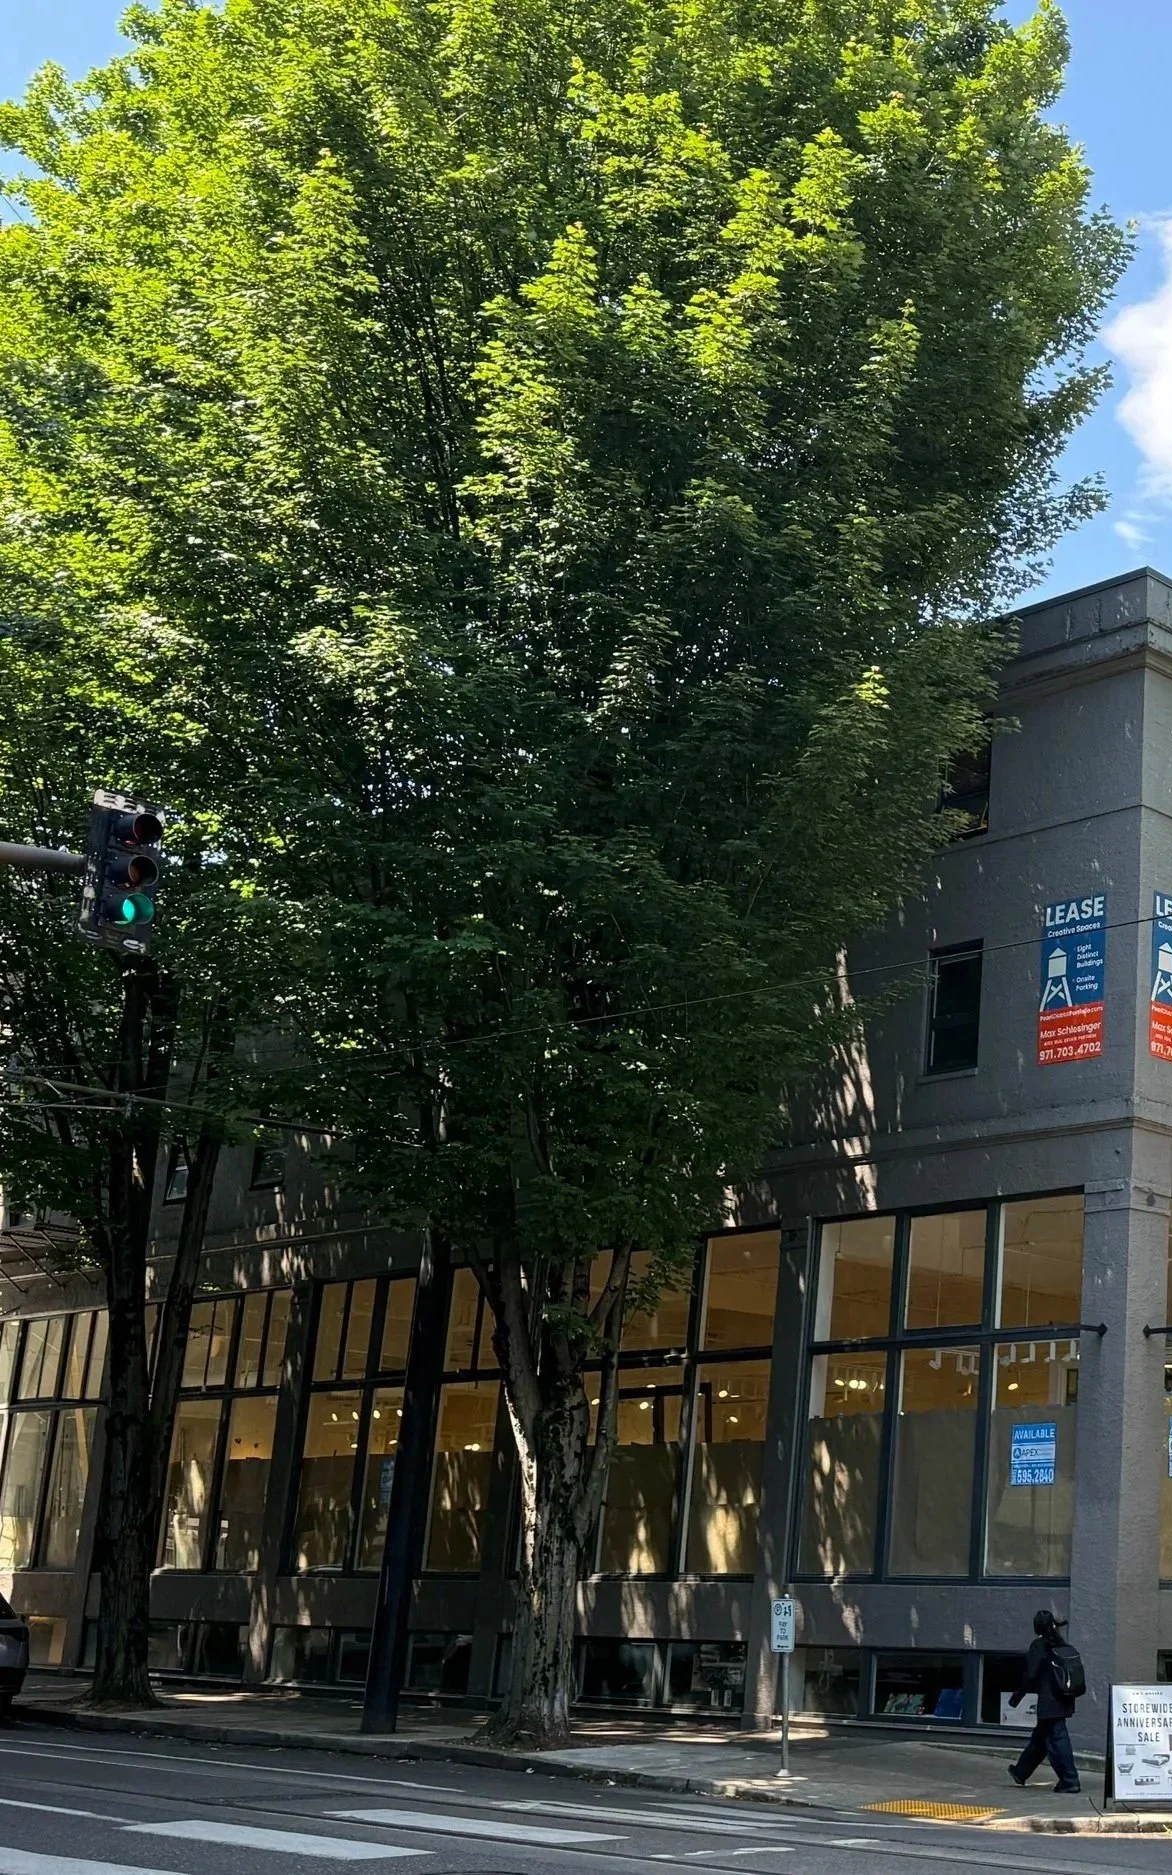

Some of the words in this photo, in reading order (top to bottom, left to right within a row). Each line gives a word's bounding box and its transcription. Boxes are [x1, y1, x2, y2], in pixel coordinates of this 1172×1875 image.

[1046, 896, 1104, 927] LEASE
[1048, 926, 1076, 938] Creative
[1076, 922, 1101, 933] Spaces
[1077, 951, 1099, 961] Distinct
[1077, 959, 1103, 969] Buildings
[1076, 974, 1095, 983] Onsite
[1076, 982, 1098, 992] Parking
[1040, 1030, 1056, 1039] Max
[1057, 1022, 1101, 1036] Schlesinger
[1152, 1020, 1166, 1033] Max
[1039, 1041, 1101, 1060] 971.703.4702
[1014, 1428, 1056, 1440] AVAILABLE
[1021, 1448, 1039, 1457] APEX
[1137, 1731, 1161, 1742] SALE
